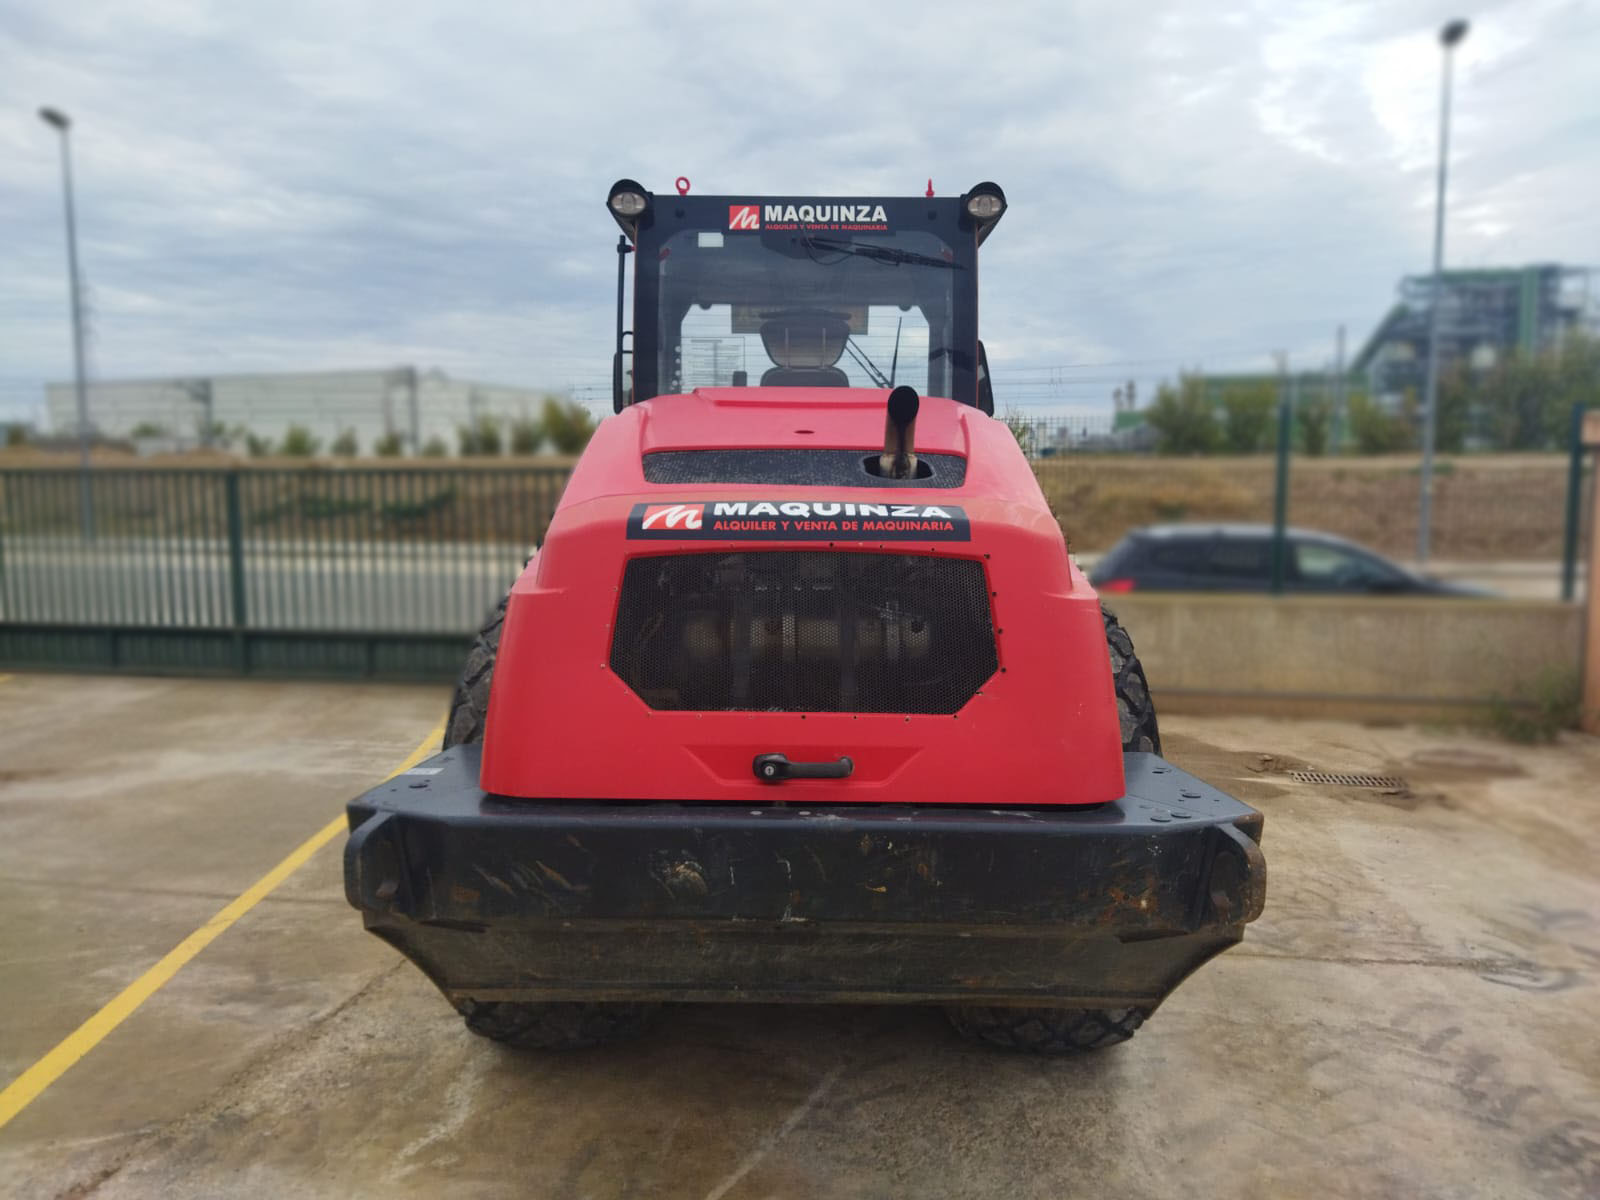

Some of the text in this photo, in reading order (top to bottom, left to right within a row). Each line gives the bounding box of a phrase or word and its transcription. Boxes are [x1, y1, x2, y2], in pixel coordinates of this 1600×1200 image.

[764, 205, 887, 222] MAQUINZA
[841, 223, 888, 231] MAQUINARIA
[713, 502, 952, 518] MAQUINZA
[713, 520, 954, 531] ALQUILER Y VENTA DE MAQUINARIA
